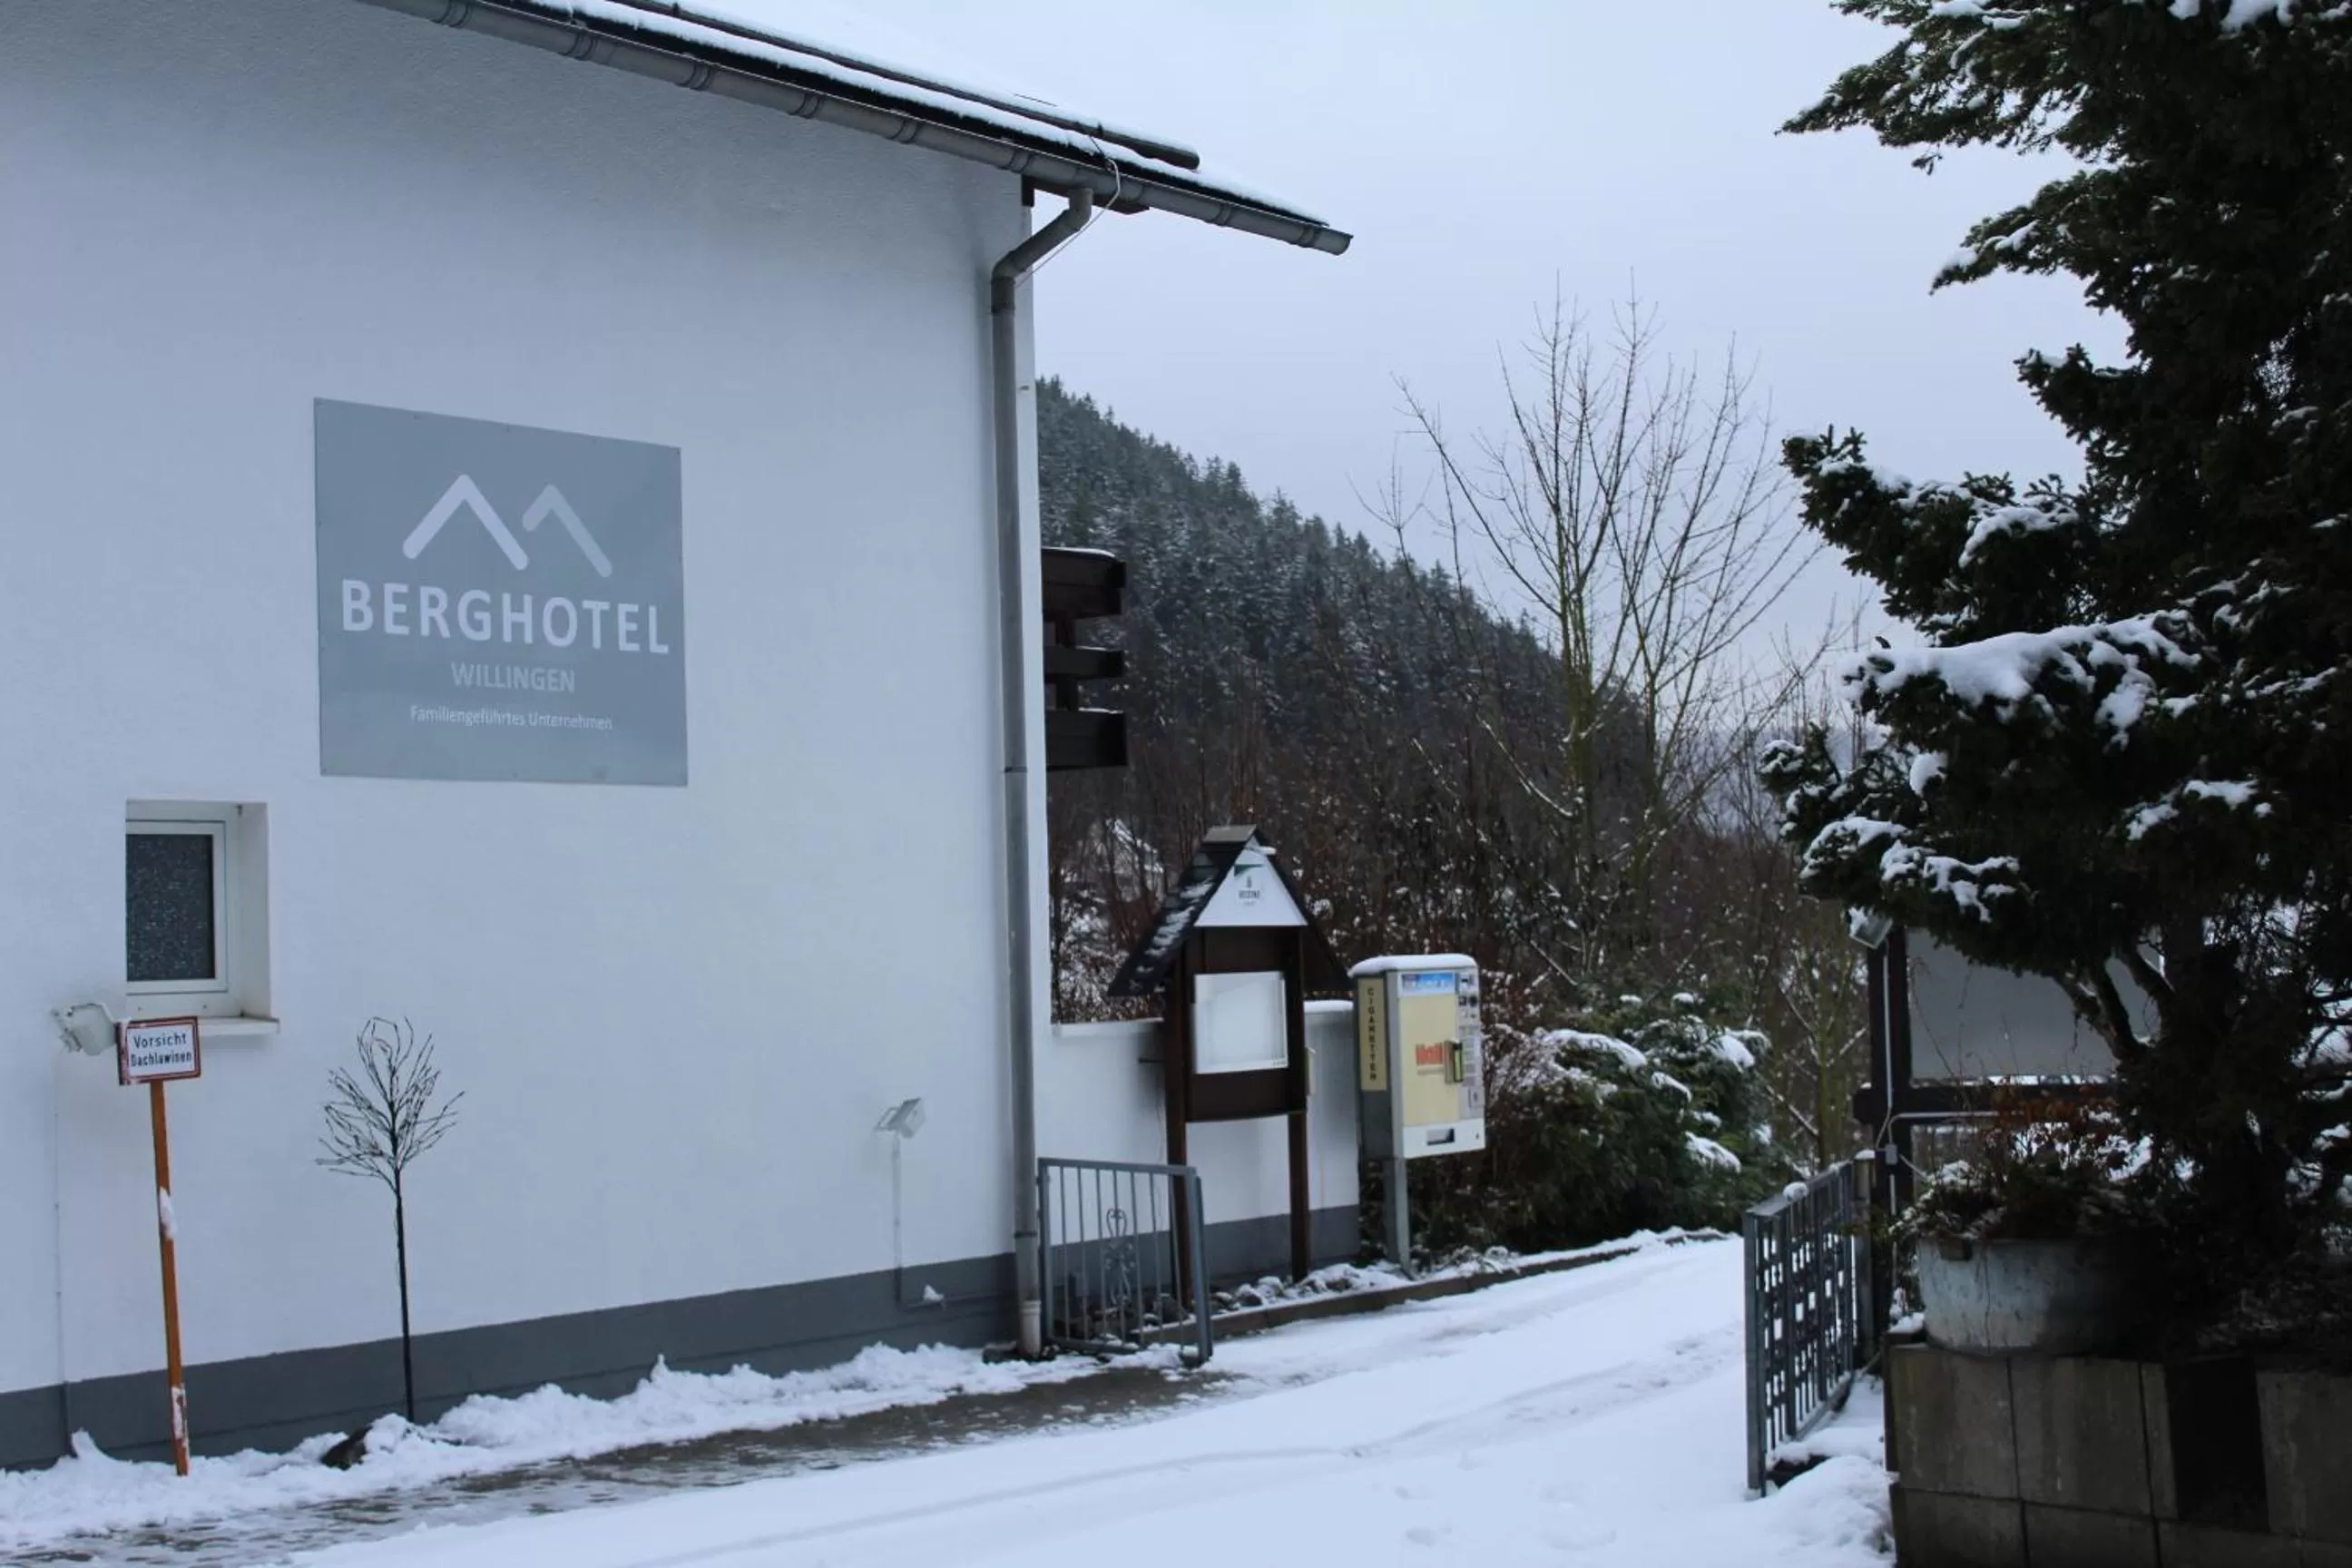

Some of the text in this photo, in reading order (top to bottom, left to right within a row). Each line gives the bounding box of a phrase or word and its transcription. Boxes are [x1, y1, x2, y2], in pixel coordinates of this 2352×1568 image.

[341, 578, 670, 654] BERGHOTEL
[451, 662, 576, 693] WILLINGEN
[411, 704, 612, 730] Familiengeführtes Unternehmen
[133, 1033, 186, 1048] Vorsicht
[131, 1052, 191, 1067] Dachlawinen
